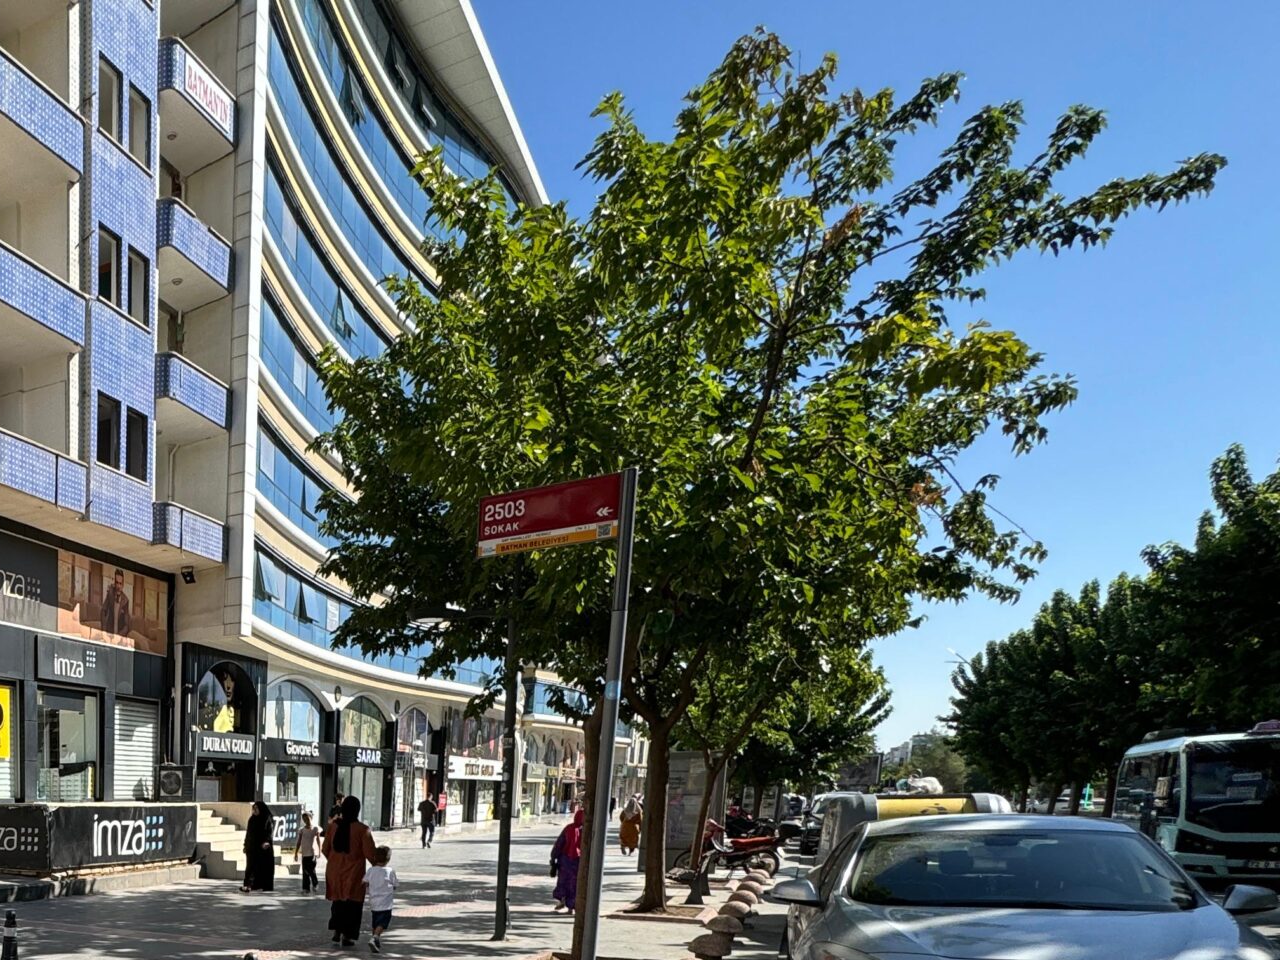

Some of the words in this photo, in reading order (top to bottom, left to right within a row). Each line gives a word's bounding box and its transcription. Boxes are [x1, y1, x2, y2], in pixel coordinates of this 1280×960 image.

[484, 499, 526, 521] 2503
[484, 522, 520, 535] SOKAK
[500, 543, 528, 552] BATMAN
[54, 653, 84, 678] imza
[202, 736, 231, 752] DURAN
[232, 739, 253, 754] GOLD
[356, 748, 381, 764] SARAR
[93, 814, 146, 857] imza
[272, 815, 286, 841] za
